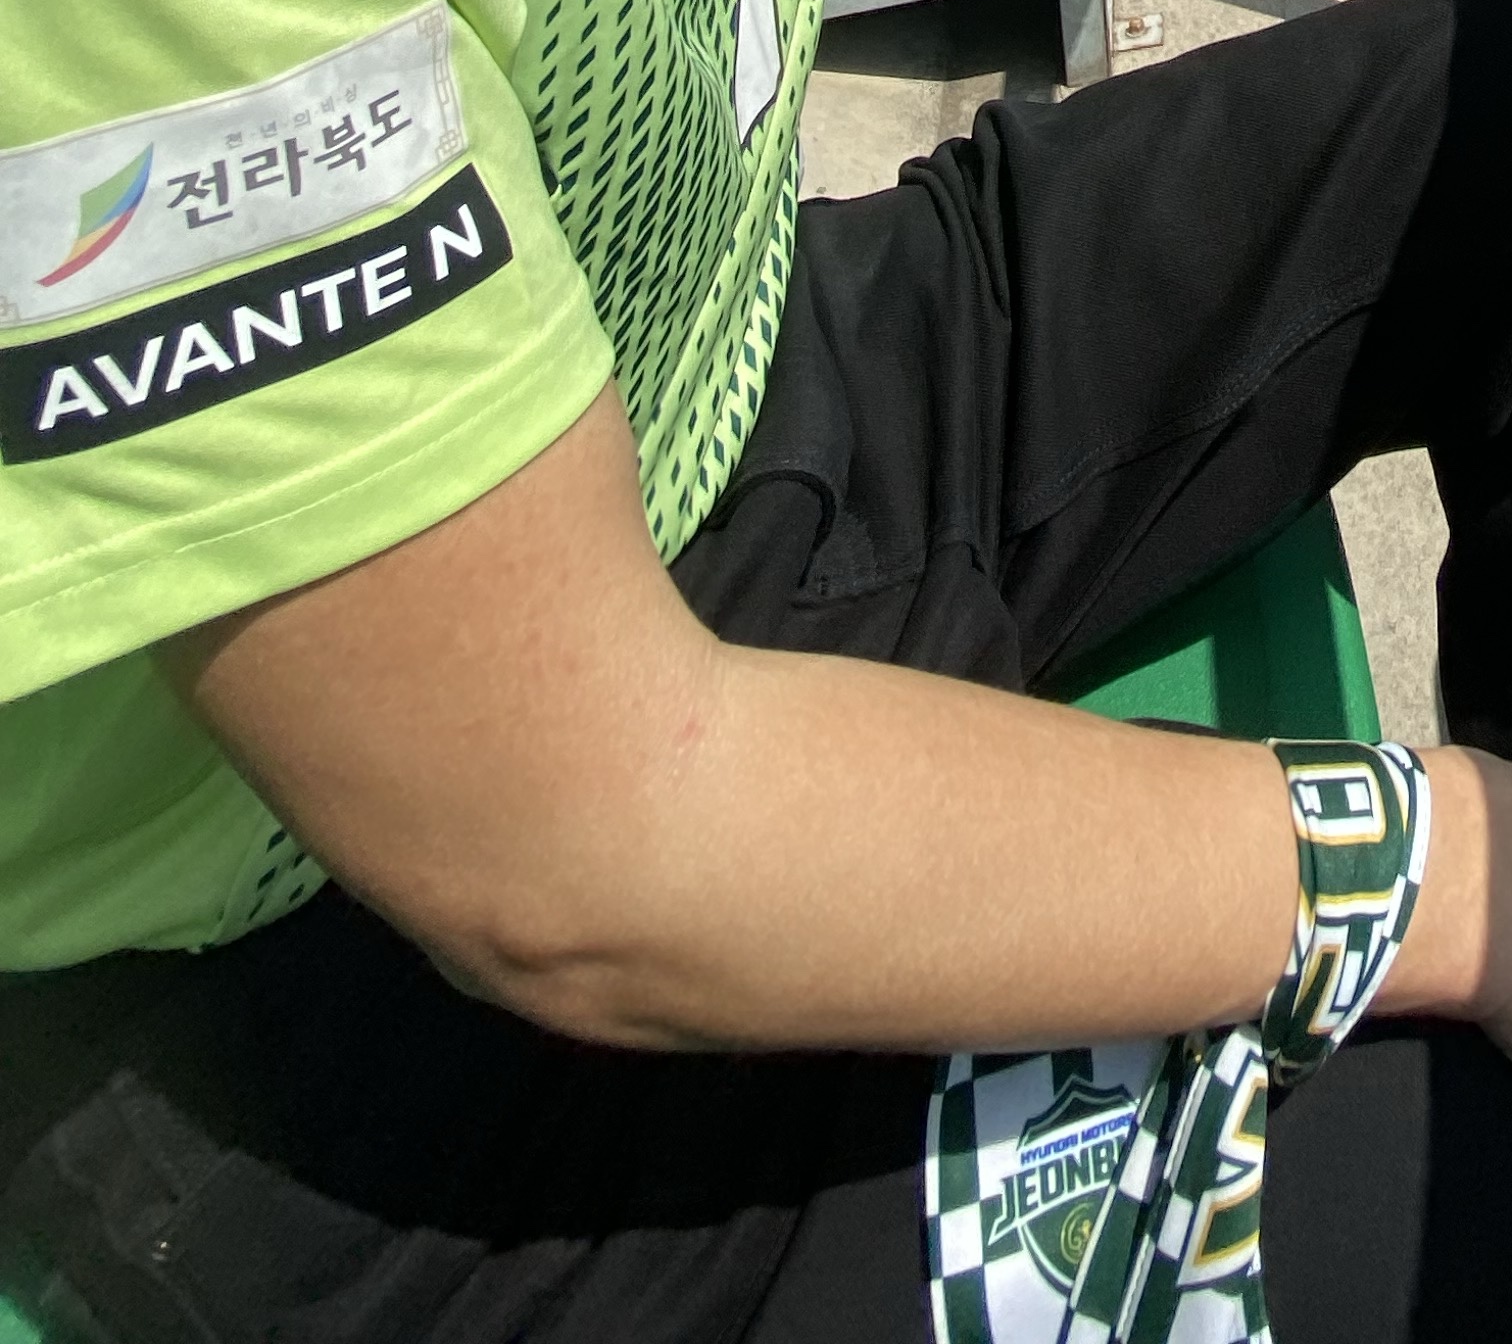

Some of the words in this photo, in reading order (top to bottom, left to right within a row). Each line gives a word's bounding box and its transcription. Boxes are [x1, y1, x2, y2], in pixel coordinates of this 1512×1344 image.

[166, 89, 413, 230] 전라북도
[36, 244, 412, 432] AVANTE
[429, 202, 485, 281] N
[1020, 1134, 1079, 1166] HYUNDAI
